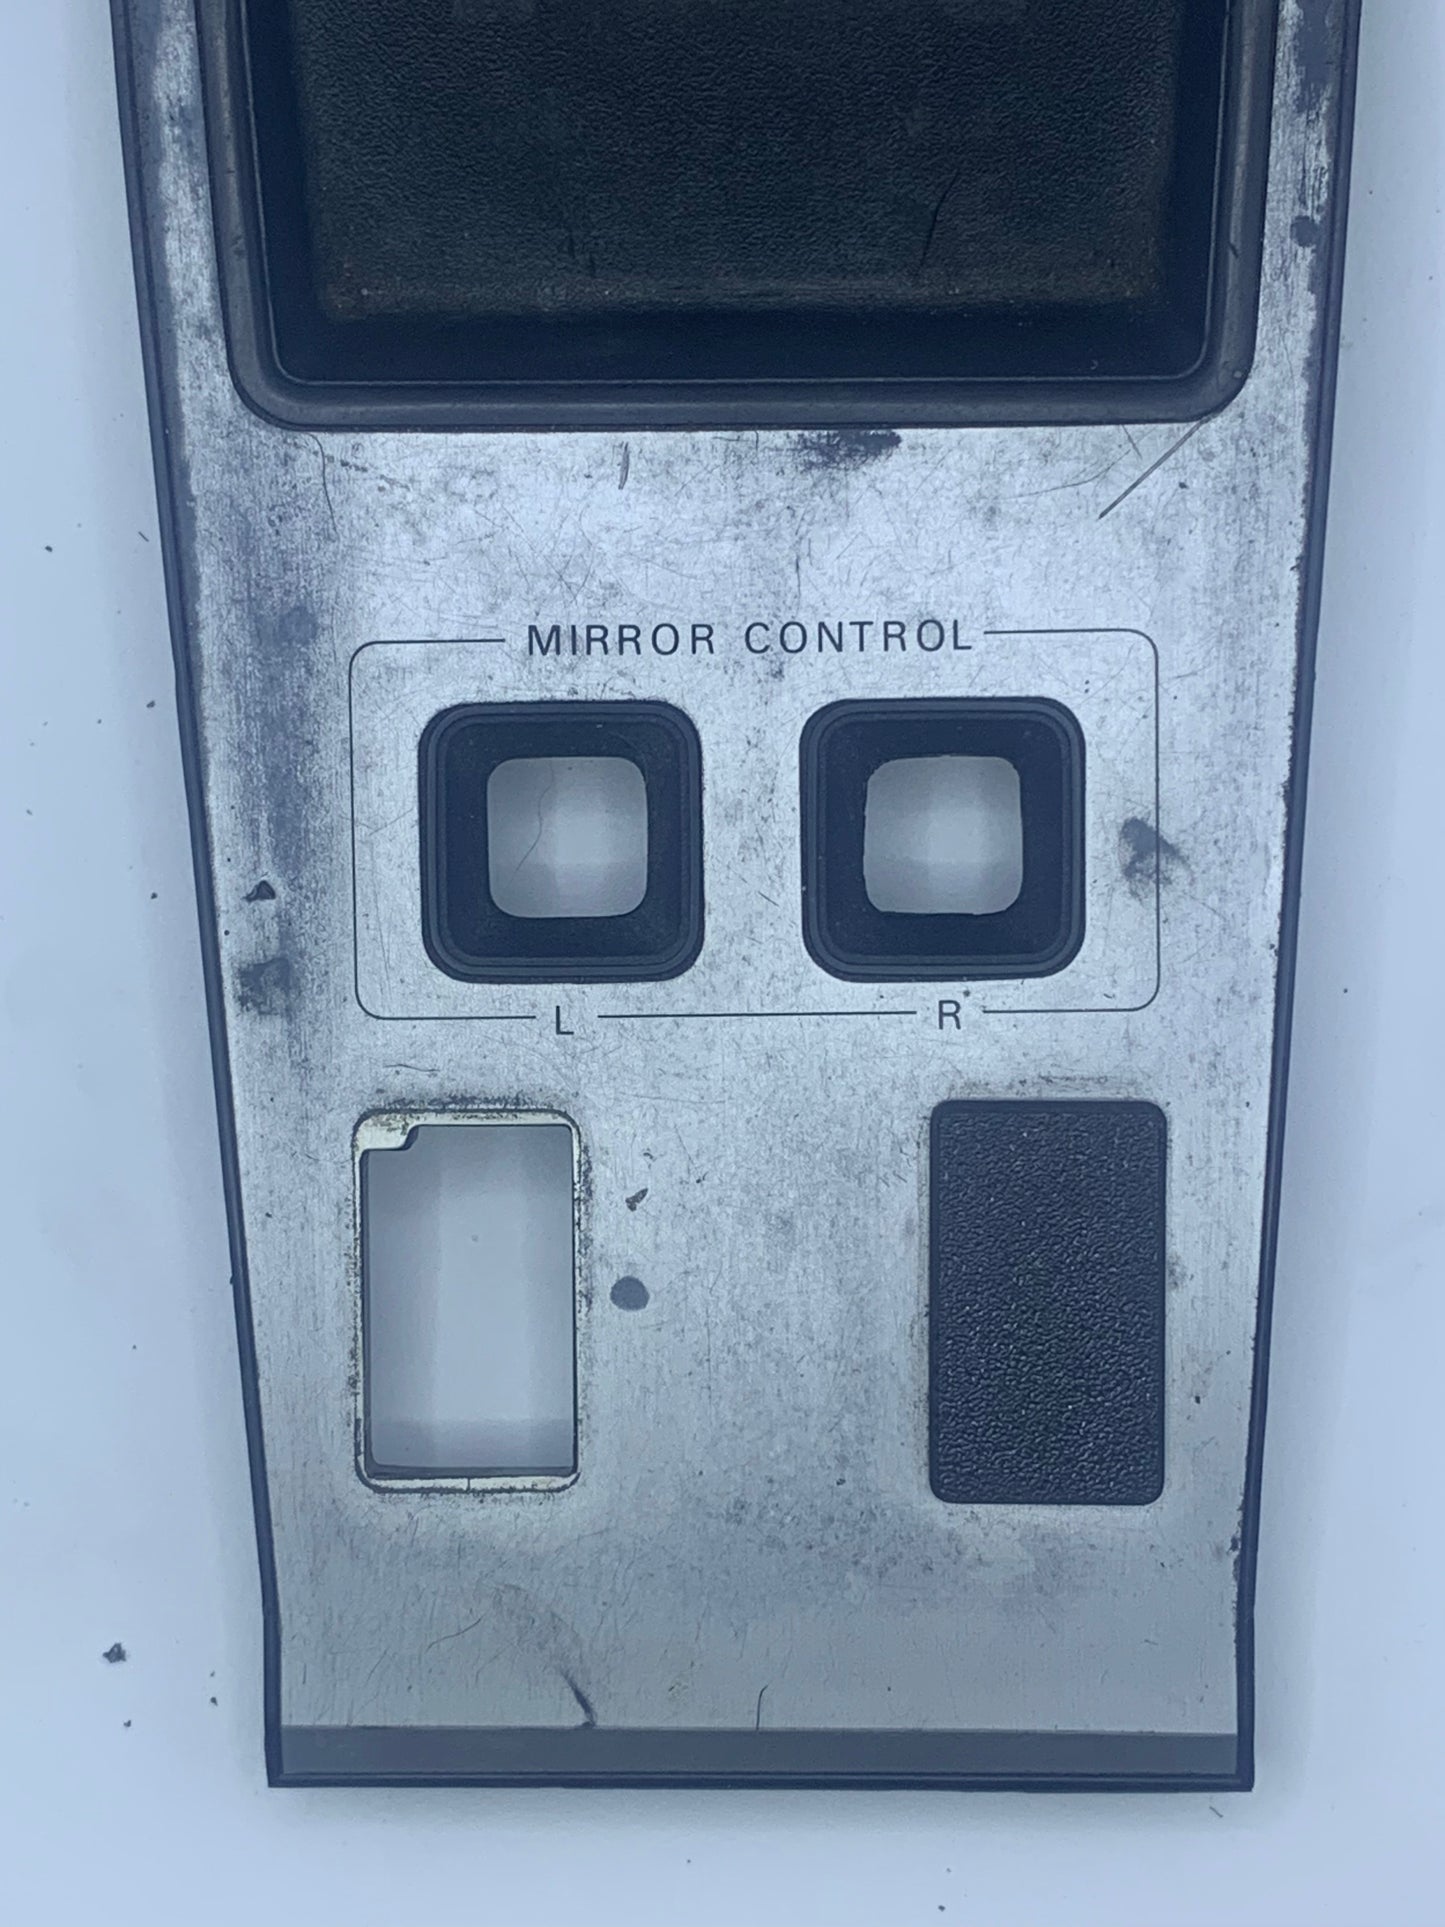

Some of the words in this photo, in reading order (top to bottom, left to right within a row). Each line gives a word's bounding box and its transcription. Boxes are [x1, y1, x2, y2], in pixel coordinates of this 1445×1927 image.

[527, 623, 715, 656] MIRROR
[744, 619, 973, 654] CONTROL
[555, 1005, 574, 1035] L
[937, 1000, 962, 1030] R
